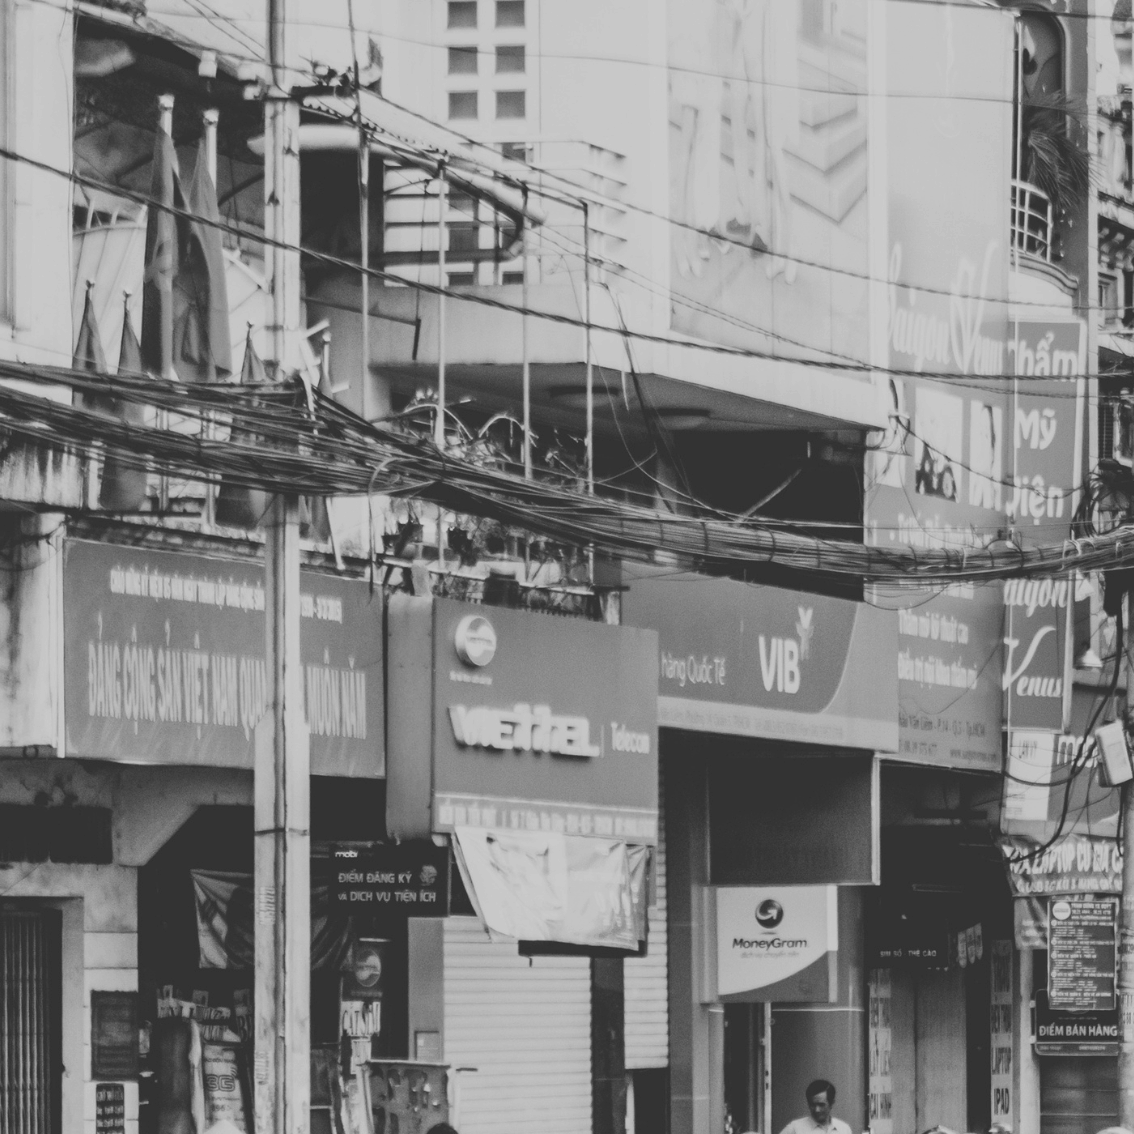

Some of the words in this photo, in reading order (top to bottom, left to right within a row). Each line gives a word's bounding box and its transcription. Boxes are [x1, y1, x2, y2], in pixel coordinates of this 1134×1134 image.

[758, 634, 800, 694] VIB
[338, 868, 364, 883] ĐIỂM
[366, 870, 395, 883] ĐĂNG
[394, 888, 417, 903] TIỆN
[732, 937, 807, 950] MoneyGram
[1039, 1021, 1064, 1036] ĐIỂM
[1065, 1022, 1087, 1036] BÁN
[1088, 1022, 1118, 1036] HÀNG
